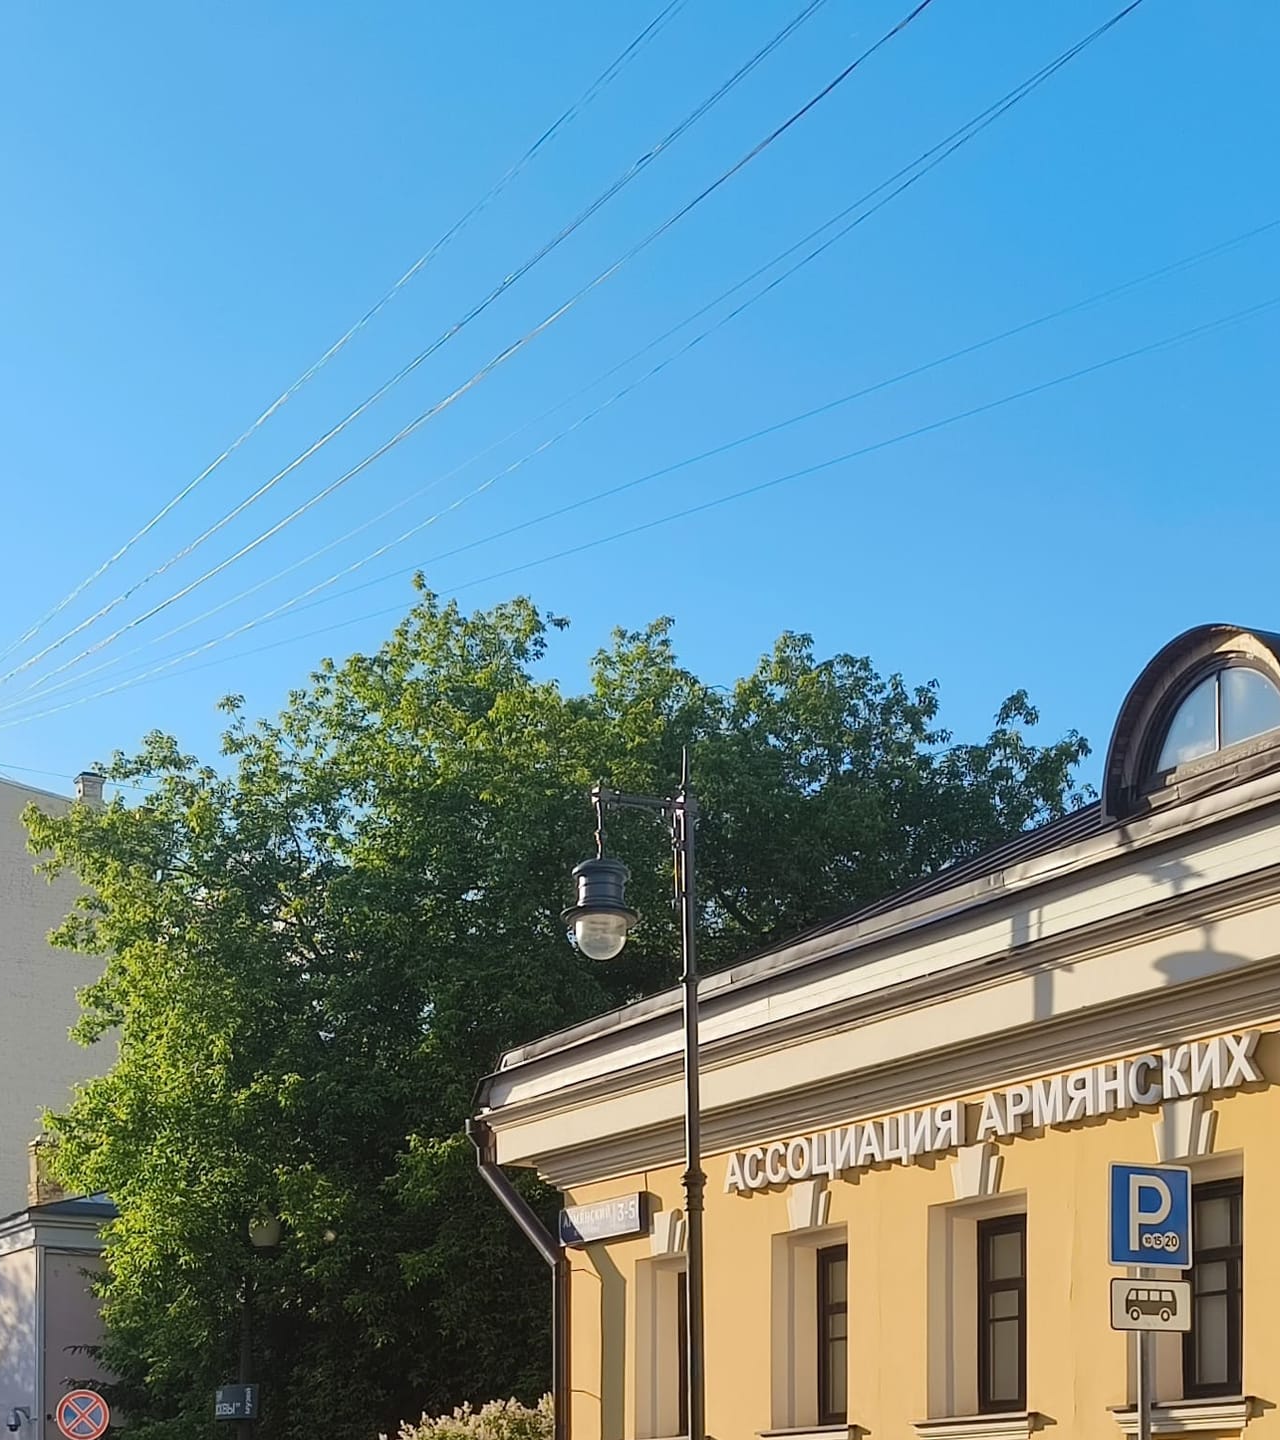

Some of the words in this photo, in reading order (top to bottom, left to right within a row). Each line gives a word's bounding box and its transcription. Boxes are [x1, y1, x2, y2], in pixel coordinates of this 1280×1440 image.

[723, 1100, 964, 1194] АССОЦИАЦИЯ
[976, 1029, 1264, 1141] АРМЯНСКИХ
[617, 1200, 636, 1222] 3-5
[1129, 1173, 1172, 1251] P
[1165, 1235, 1178, 1247] 20
